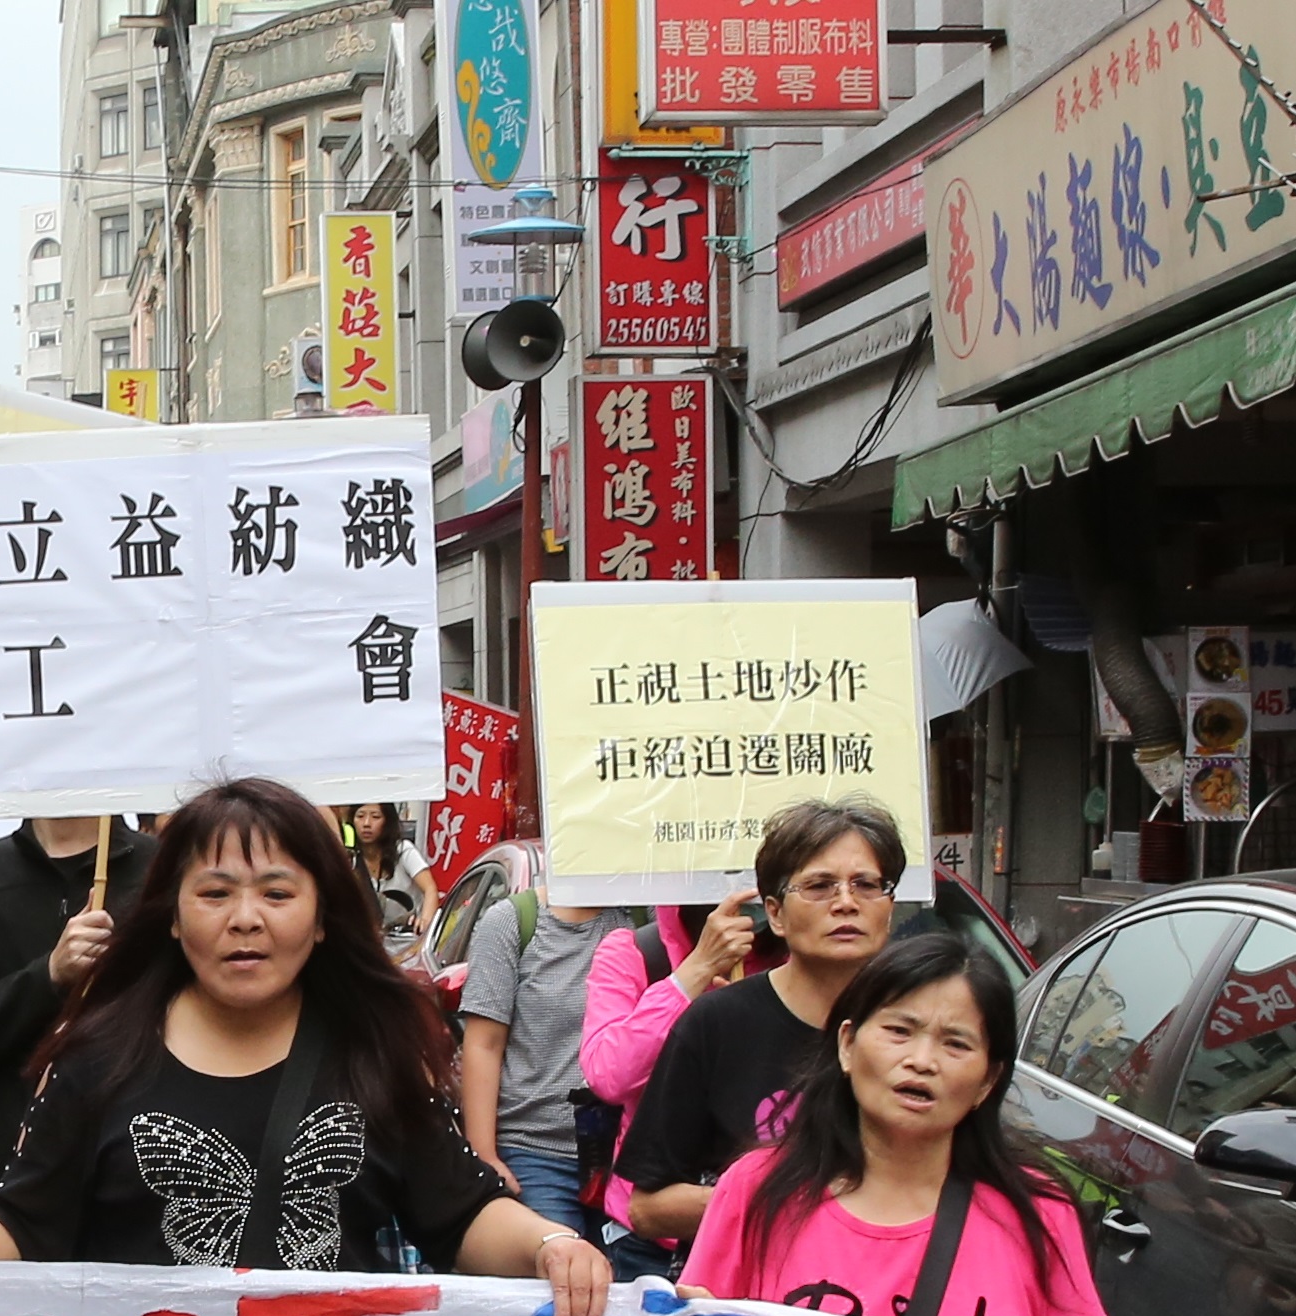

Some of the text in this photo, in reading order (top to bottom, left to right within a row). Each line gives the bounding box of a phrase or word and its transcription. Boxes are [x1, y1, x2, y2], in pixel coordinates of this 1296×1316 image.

[661, 65, 873, 104] 批發零售
[613, 176, 699, 262] 行
[946, 190, 977, 346] 華
[606, 281, 705, 307] 訂購專線
[606, 314, 707, 345] 25560545
[589, 658, 870, 708] 正視土地炒作
[595, 731, 875, 784] 拒絕迫遷關廠
